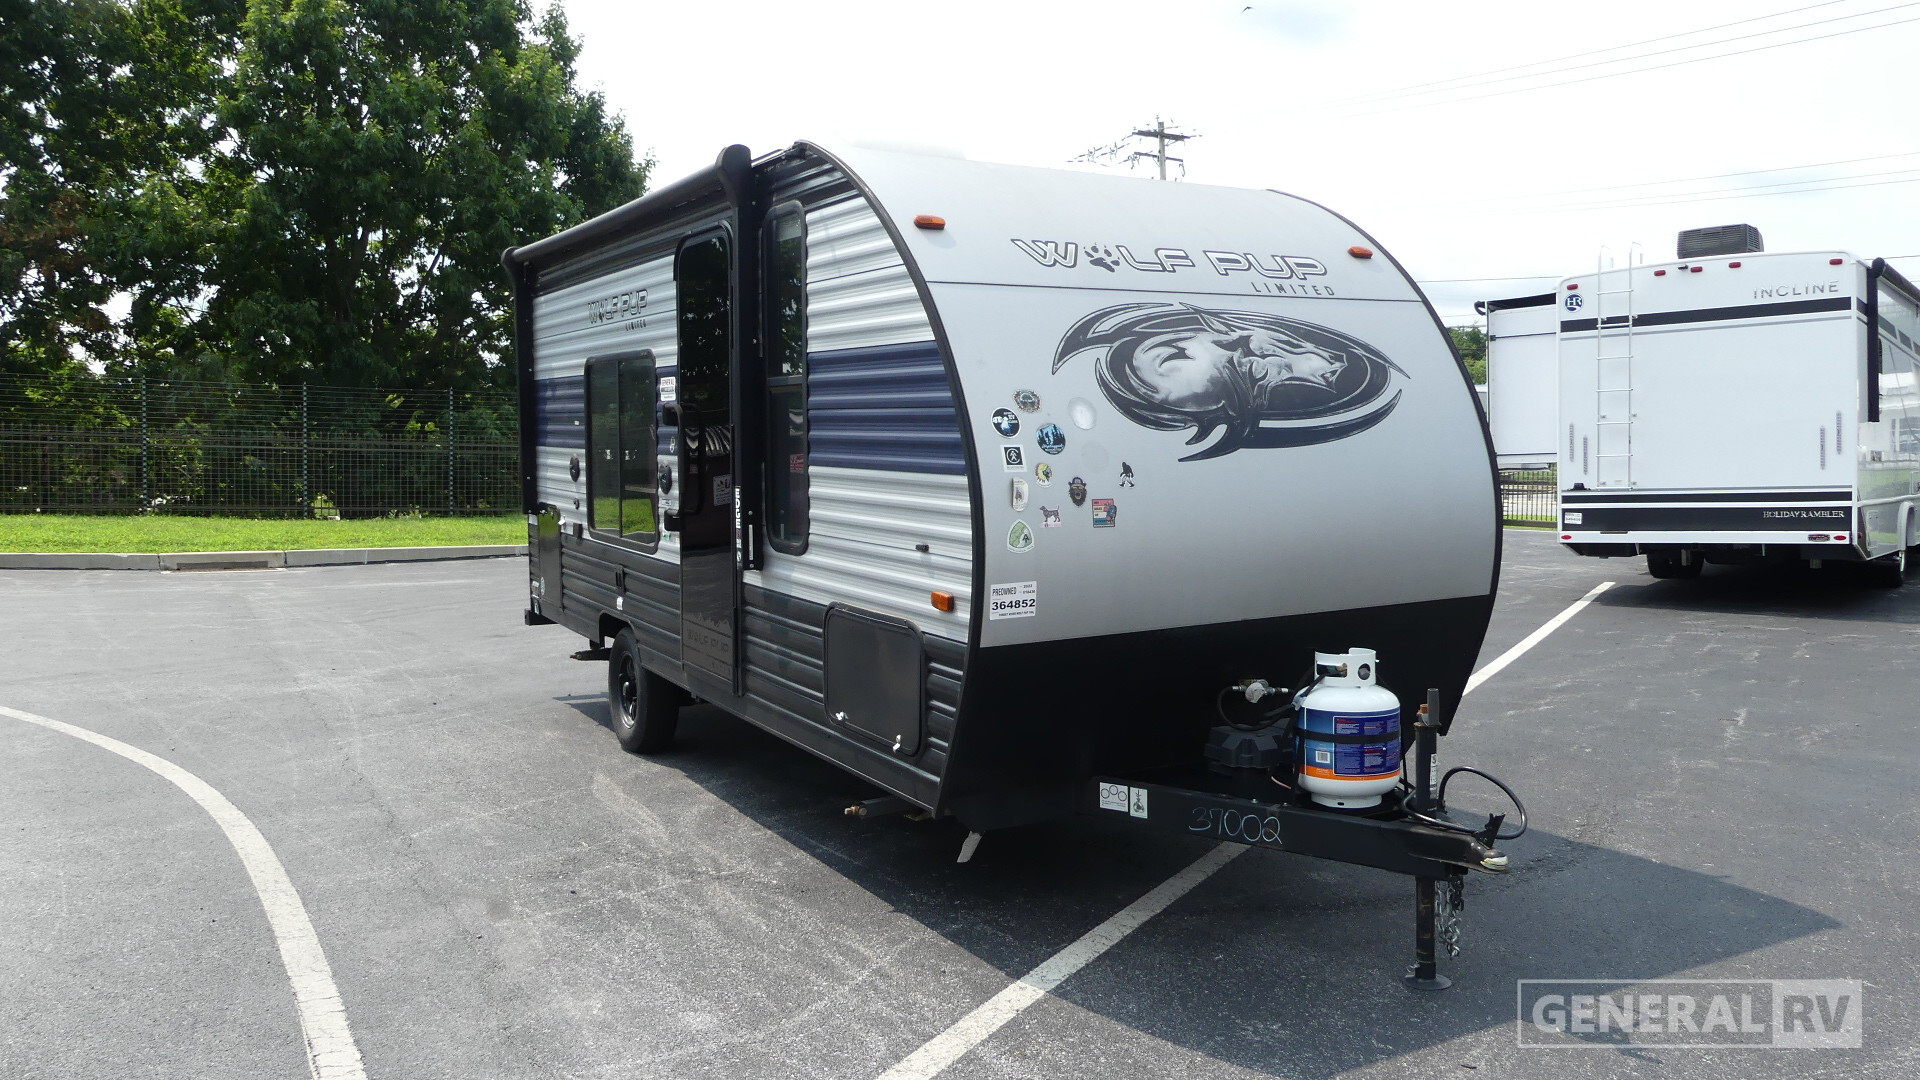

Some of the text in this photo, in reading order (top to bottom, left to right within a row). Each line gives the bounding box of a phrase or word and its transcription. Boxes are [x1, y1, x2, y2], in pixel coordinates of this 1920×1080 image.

[1203, 250, 1328, 281] PUP
[1252, 282, 1335, 296] LIMITED
[1753, 280, 1839, 299] INCLINE
[621, 289, 648, 318] PUP
[1801, 510, 1845, 518] RAMBLER
[992, 587, 1016, 596] PREOWNED
[992, 599, 1035, 610] 364852
[1189, 807, 1283, 845] 37002
